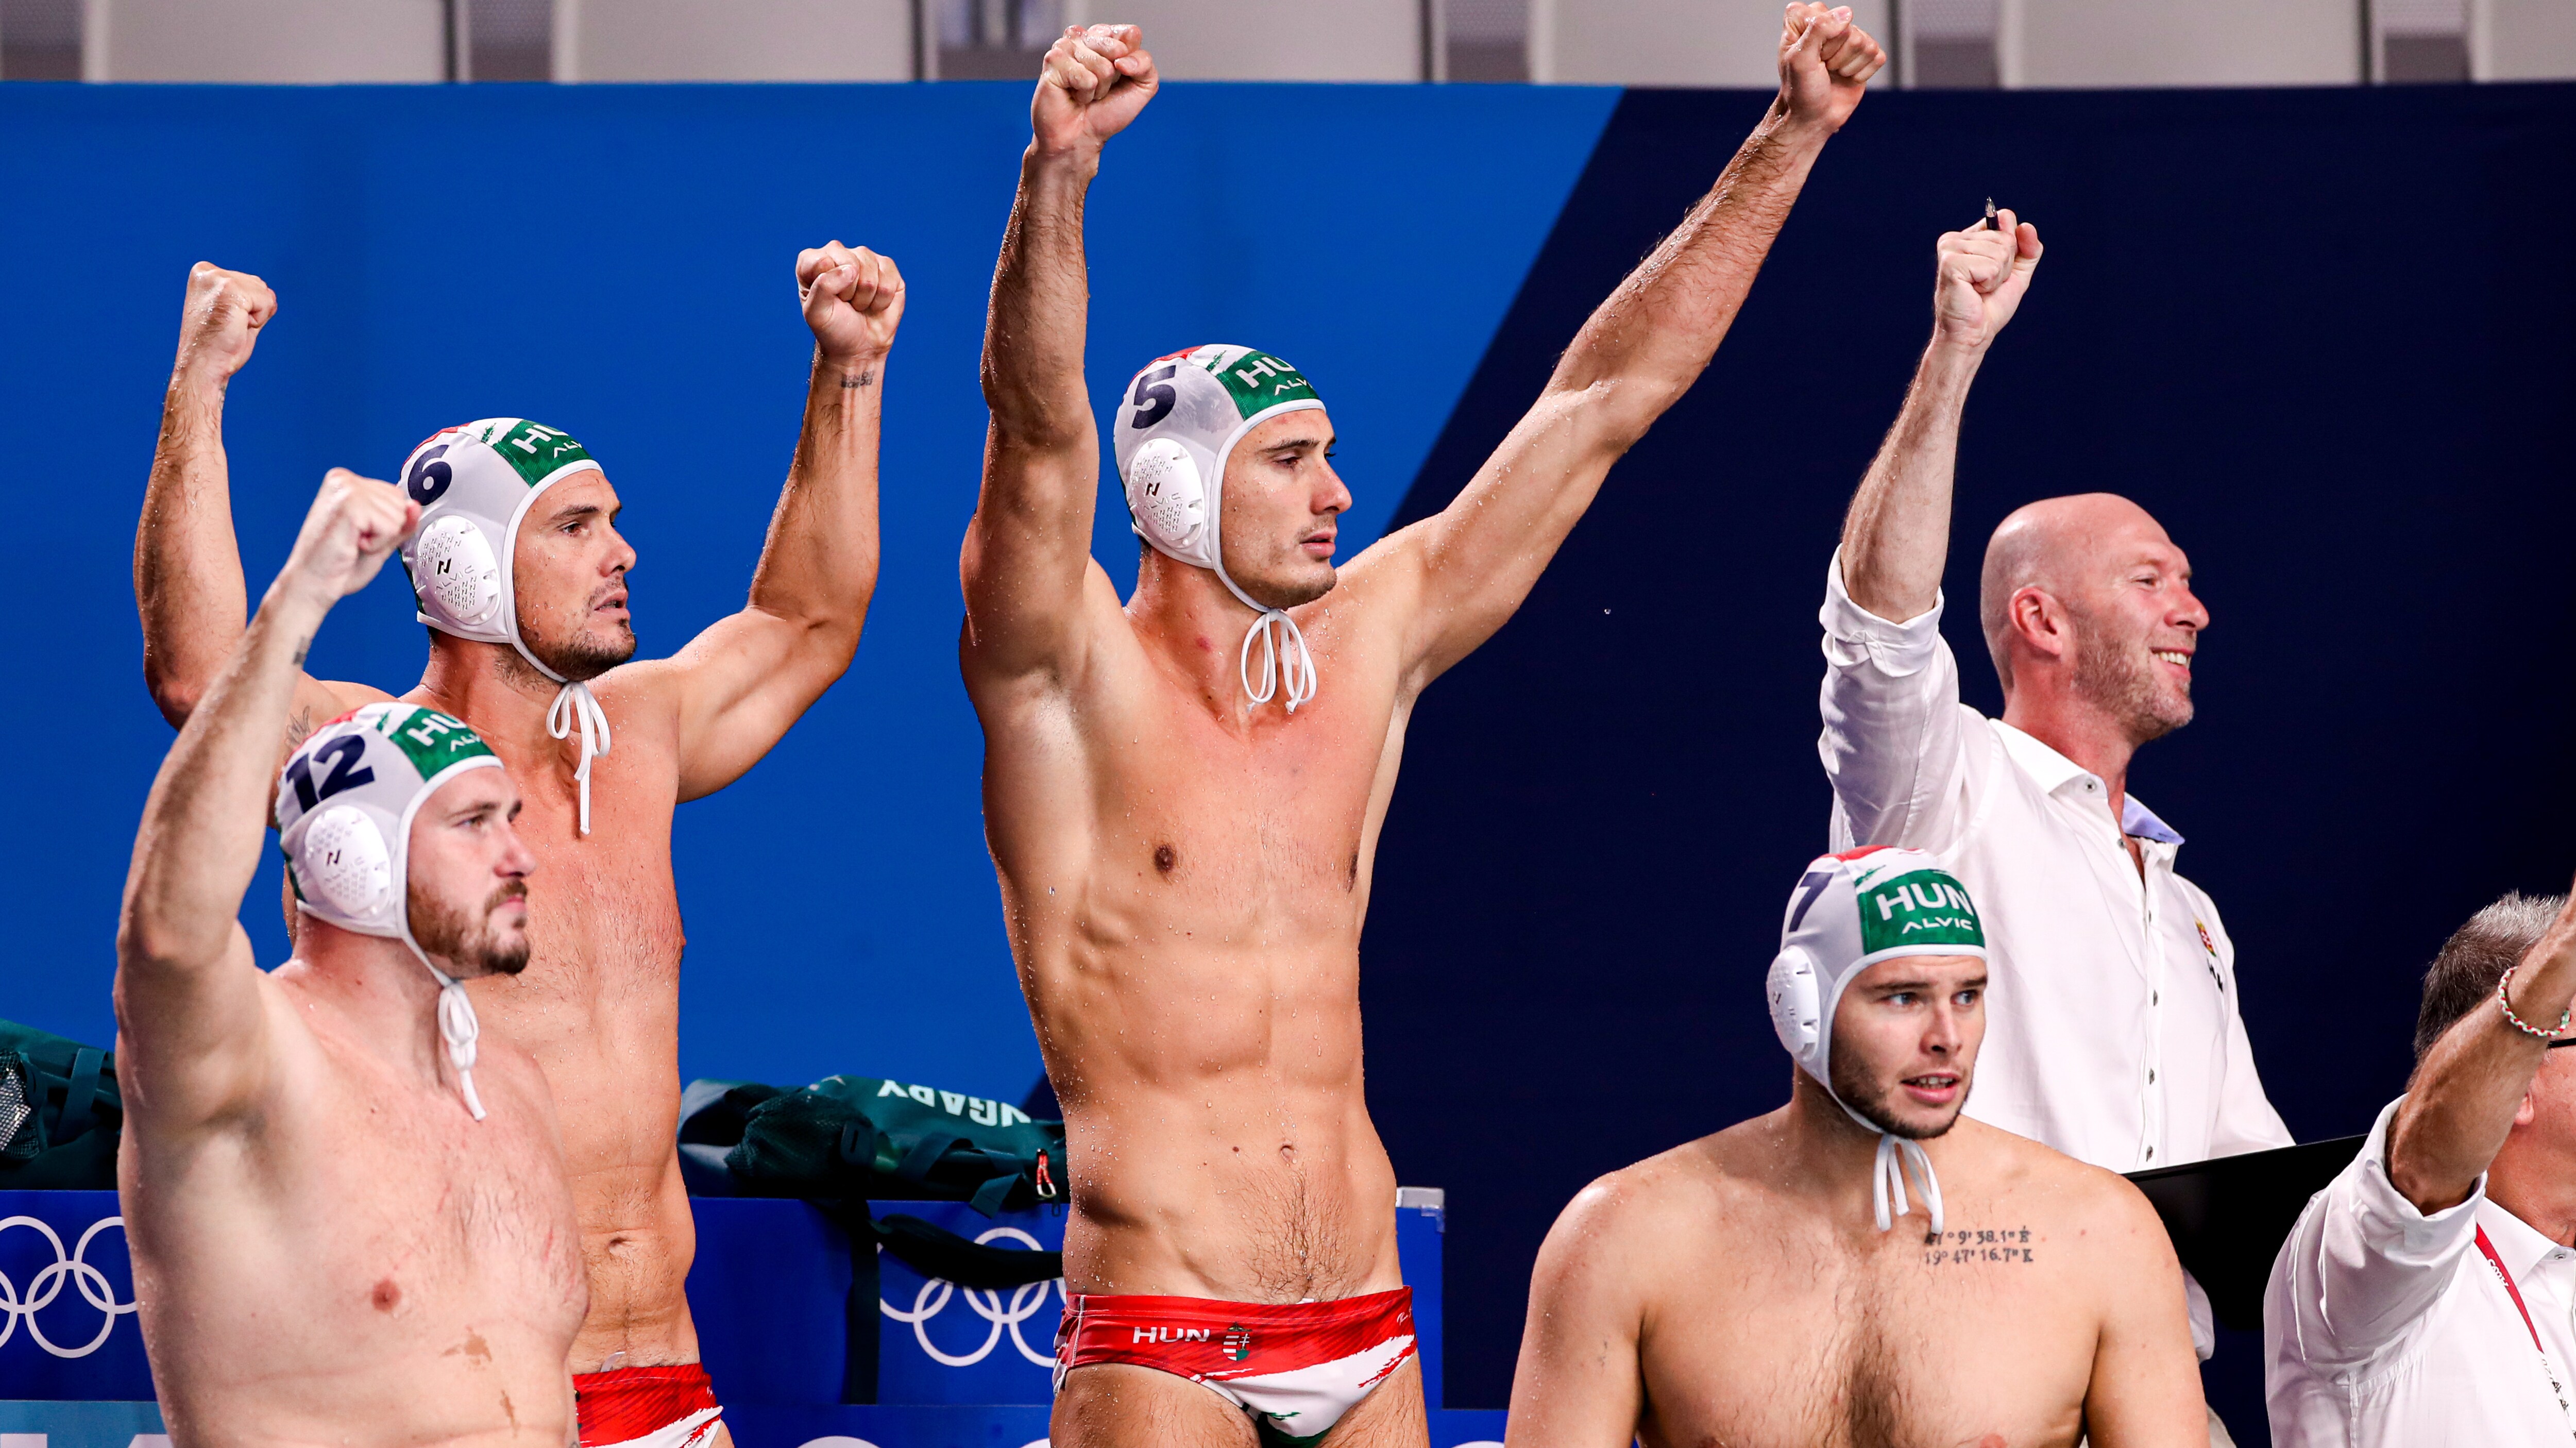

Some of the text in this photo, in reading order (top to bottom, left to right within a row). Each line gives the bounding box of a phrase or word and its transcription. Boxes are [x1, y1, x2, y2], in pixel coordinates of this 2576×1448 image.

[1132, 365, 1176, 429] 5
[408, 445, 452, 506] 6
[286, 735, 375, 813] 12
[1789, 872, 1834, 932] 7
[1876, 883, 1974, 920] HUN
[1902, 916, 1973, 934] ALVIC
[1132, 1326, 1211, 1344] HUN
